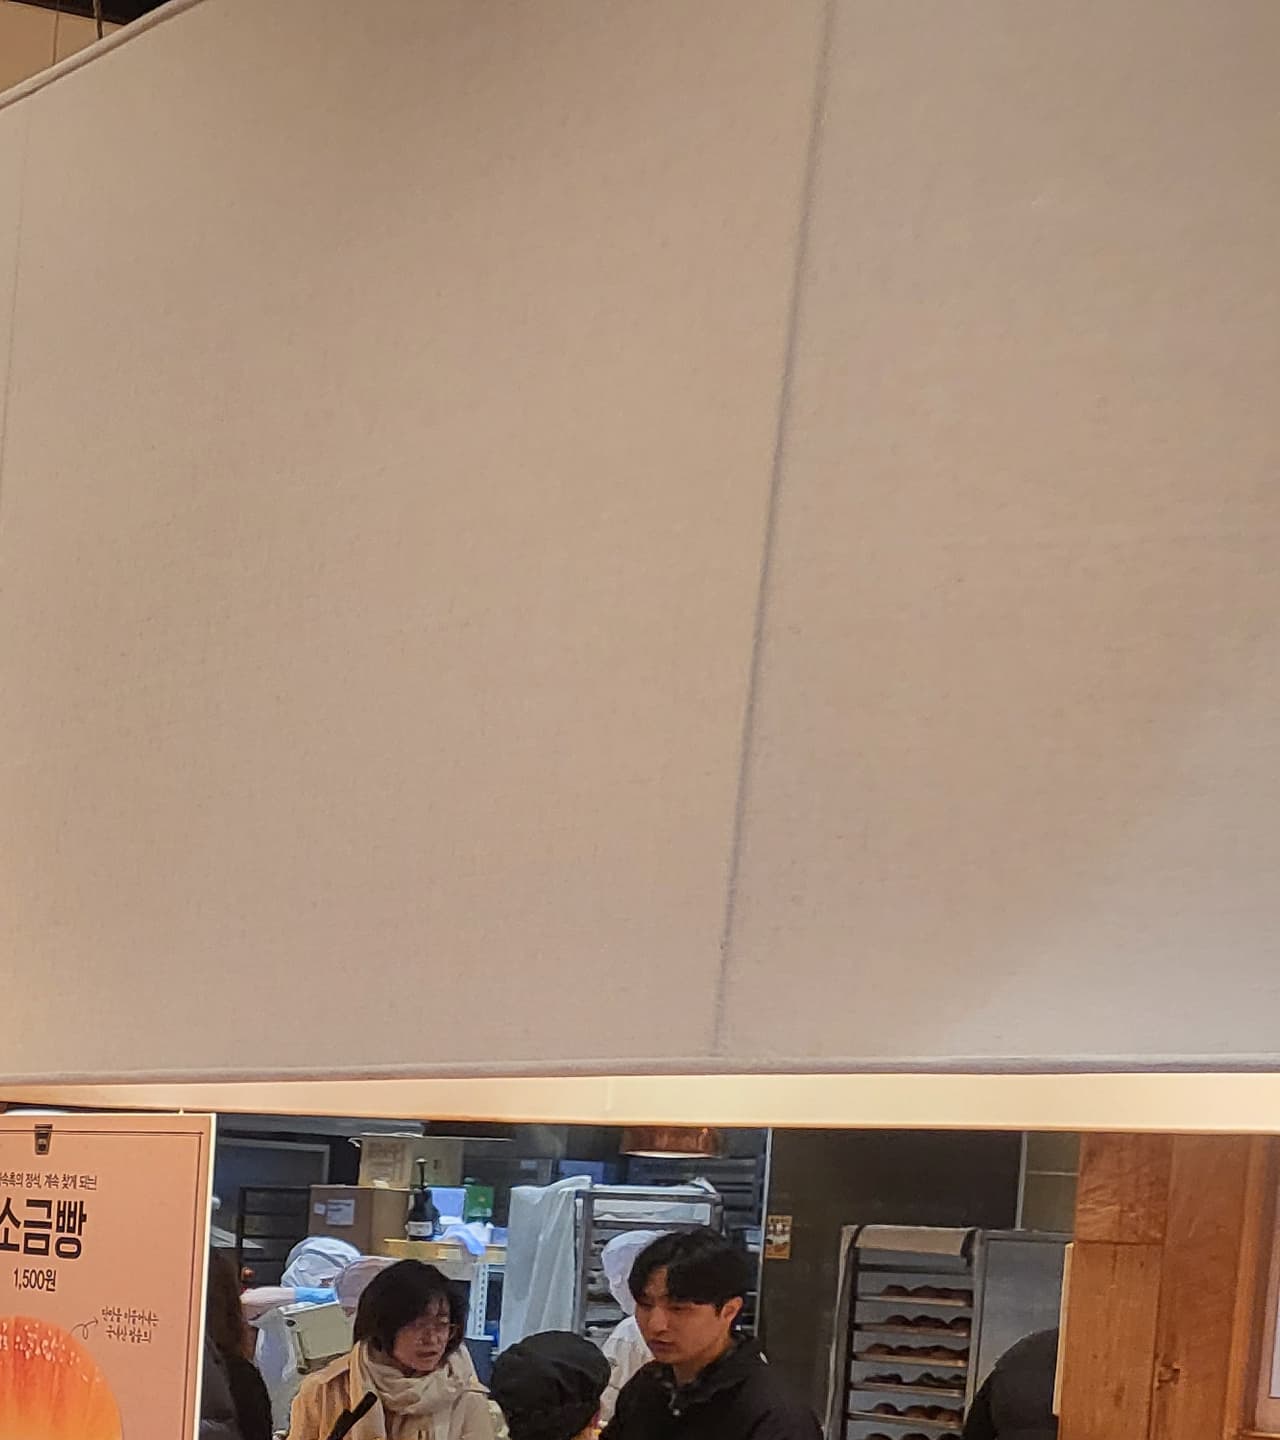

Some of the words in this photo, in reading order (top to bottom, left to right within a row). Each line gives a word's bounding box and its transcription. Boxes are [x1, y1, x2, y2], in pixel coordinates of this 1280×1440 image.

[44, 1173, 60, 1190] 계속
[62, 1174, 77, 1190] 찾게
[79, 1175, 97, 1191] 되는
[13, 1267, 56, 1292] 1,500원
